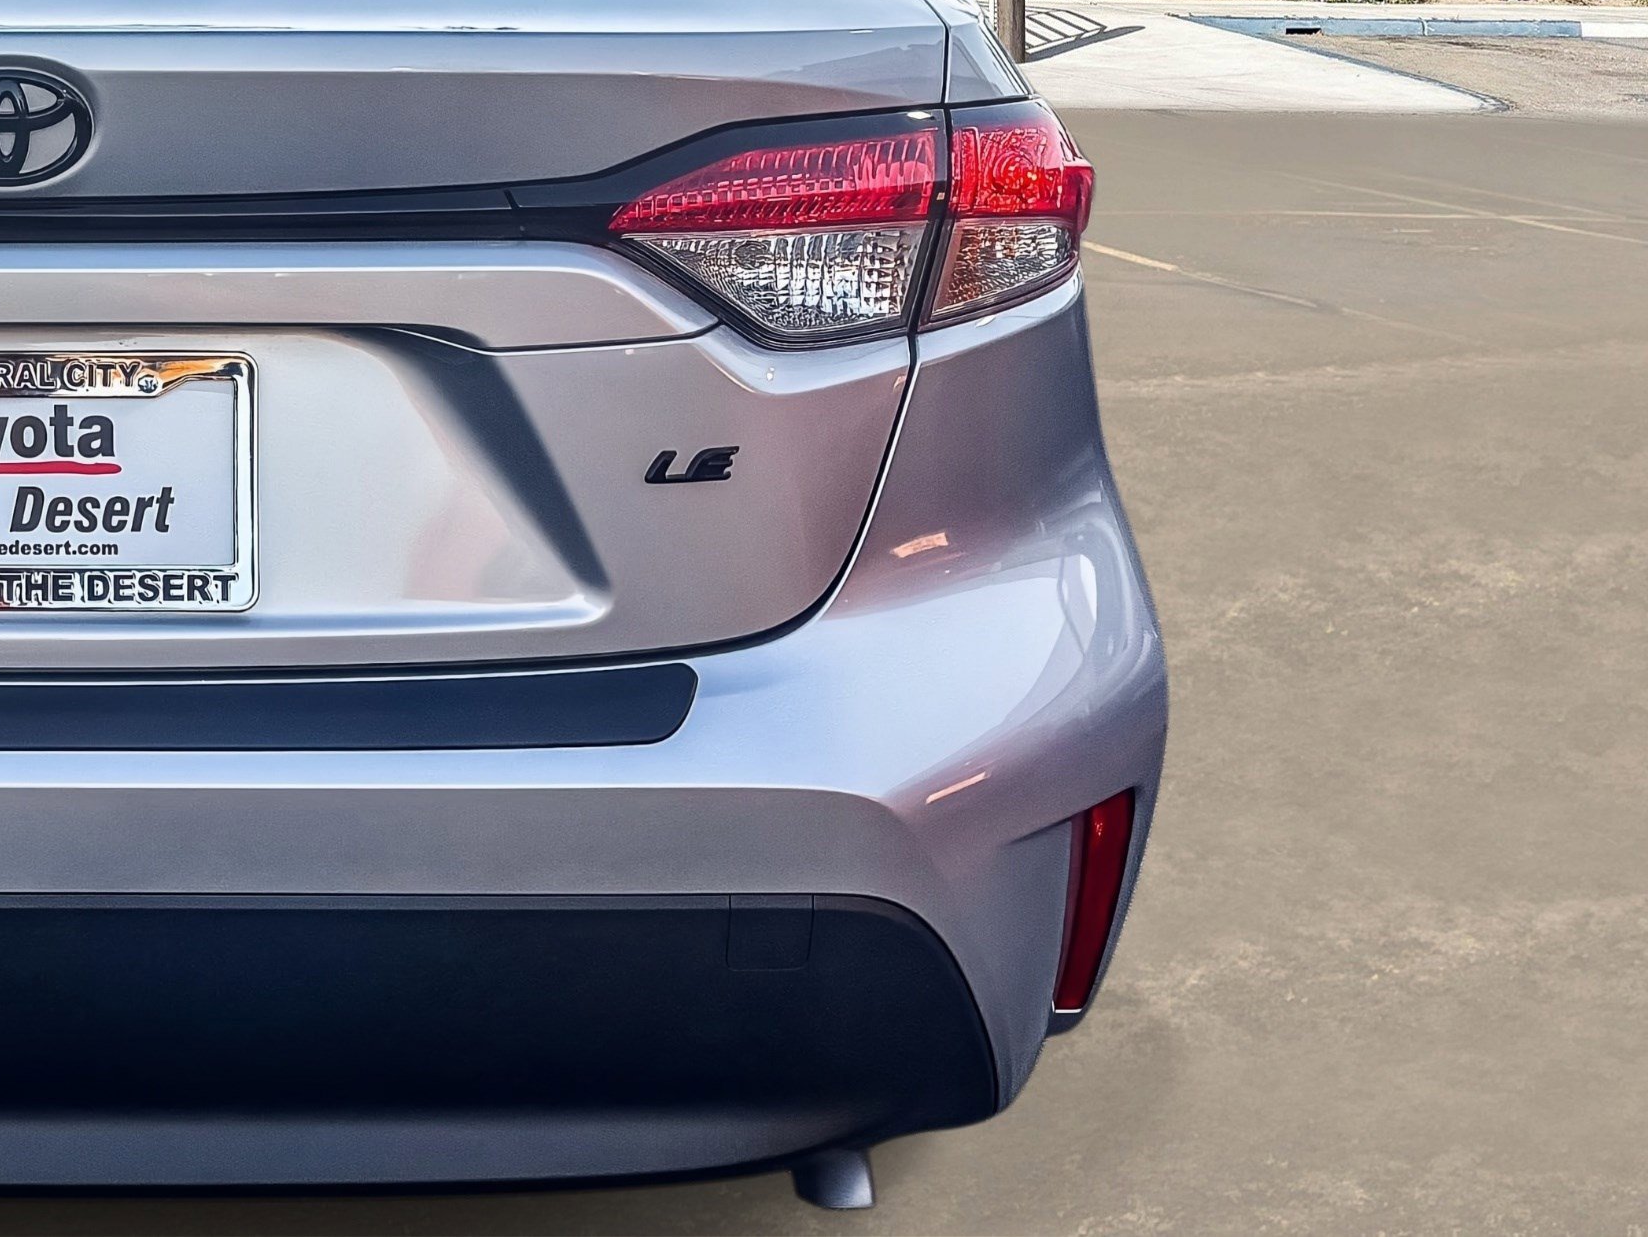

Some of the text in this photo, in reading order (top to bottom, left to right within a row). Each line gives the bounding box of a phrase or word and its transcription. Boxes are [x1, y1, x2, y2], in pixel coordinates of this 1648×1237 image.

[60, 361, 140, 391] CITY
[644, 446, 740, 484] LE
[10, 486, 175, 533] Desert
[2, 571, 74, 604] THE
[83, 571, 238, 604] DESERT
